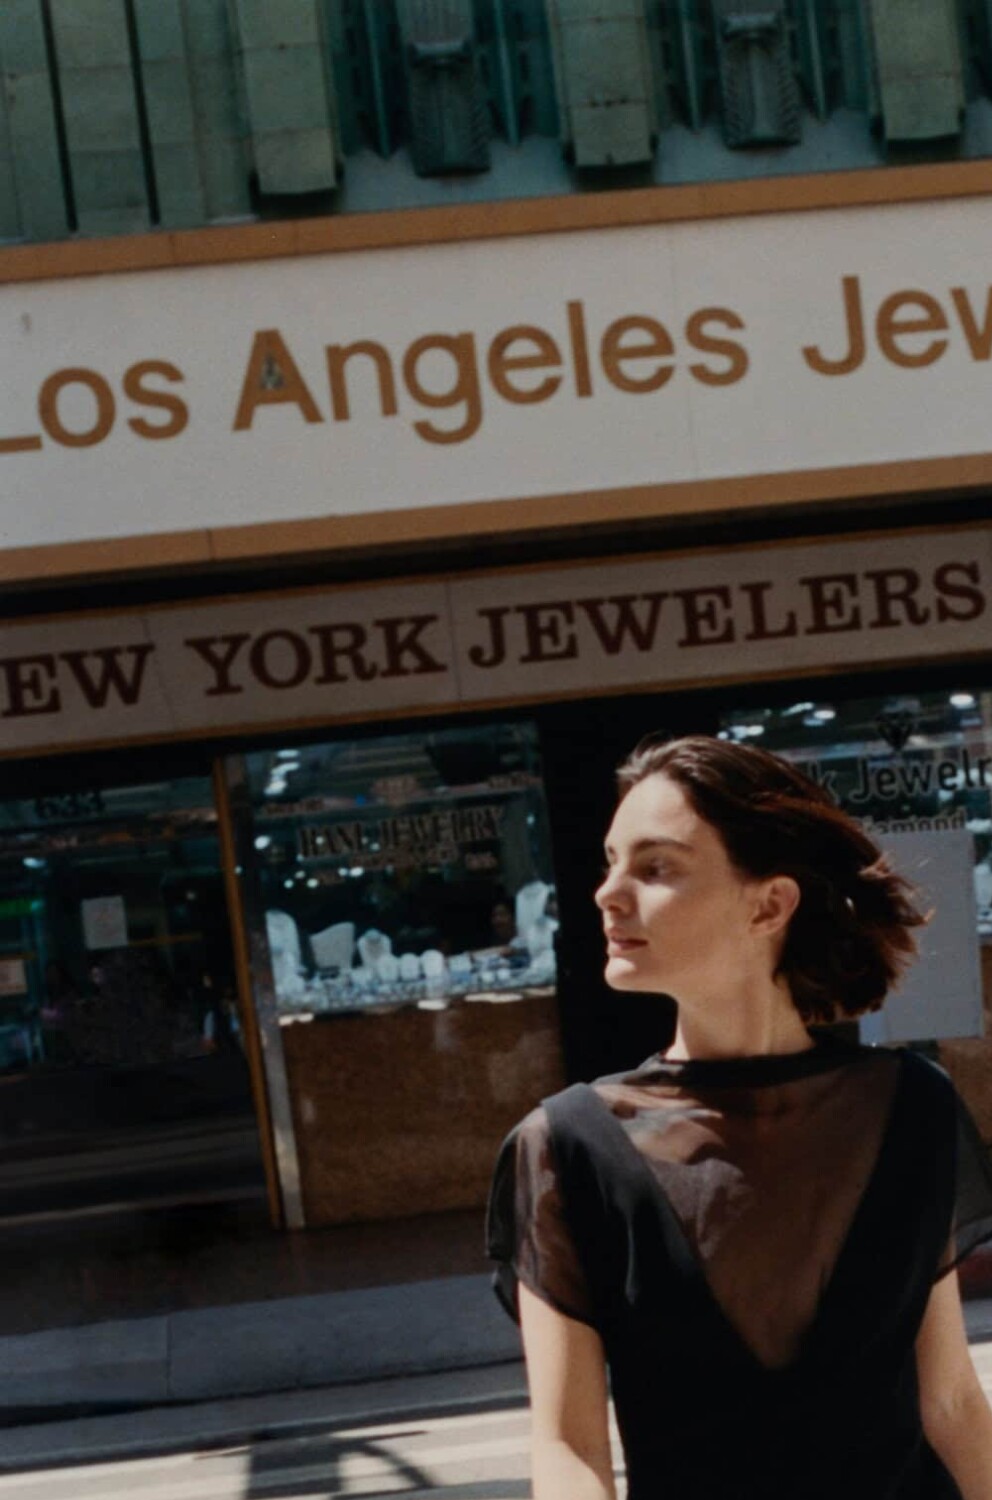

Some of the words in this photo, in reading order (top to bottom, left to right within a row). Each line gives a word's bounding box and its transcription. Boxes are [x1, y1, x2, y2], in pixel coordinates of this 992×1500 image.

[233, 300, 749, 445] Angeles
[184, 613, 448, 698] YORK
[468, 561, 987, 670] JEWELERS
